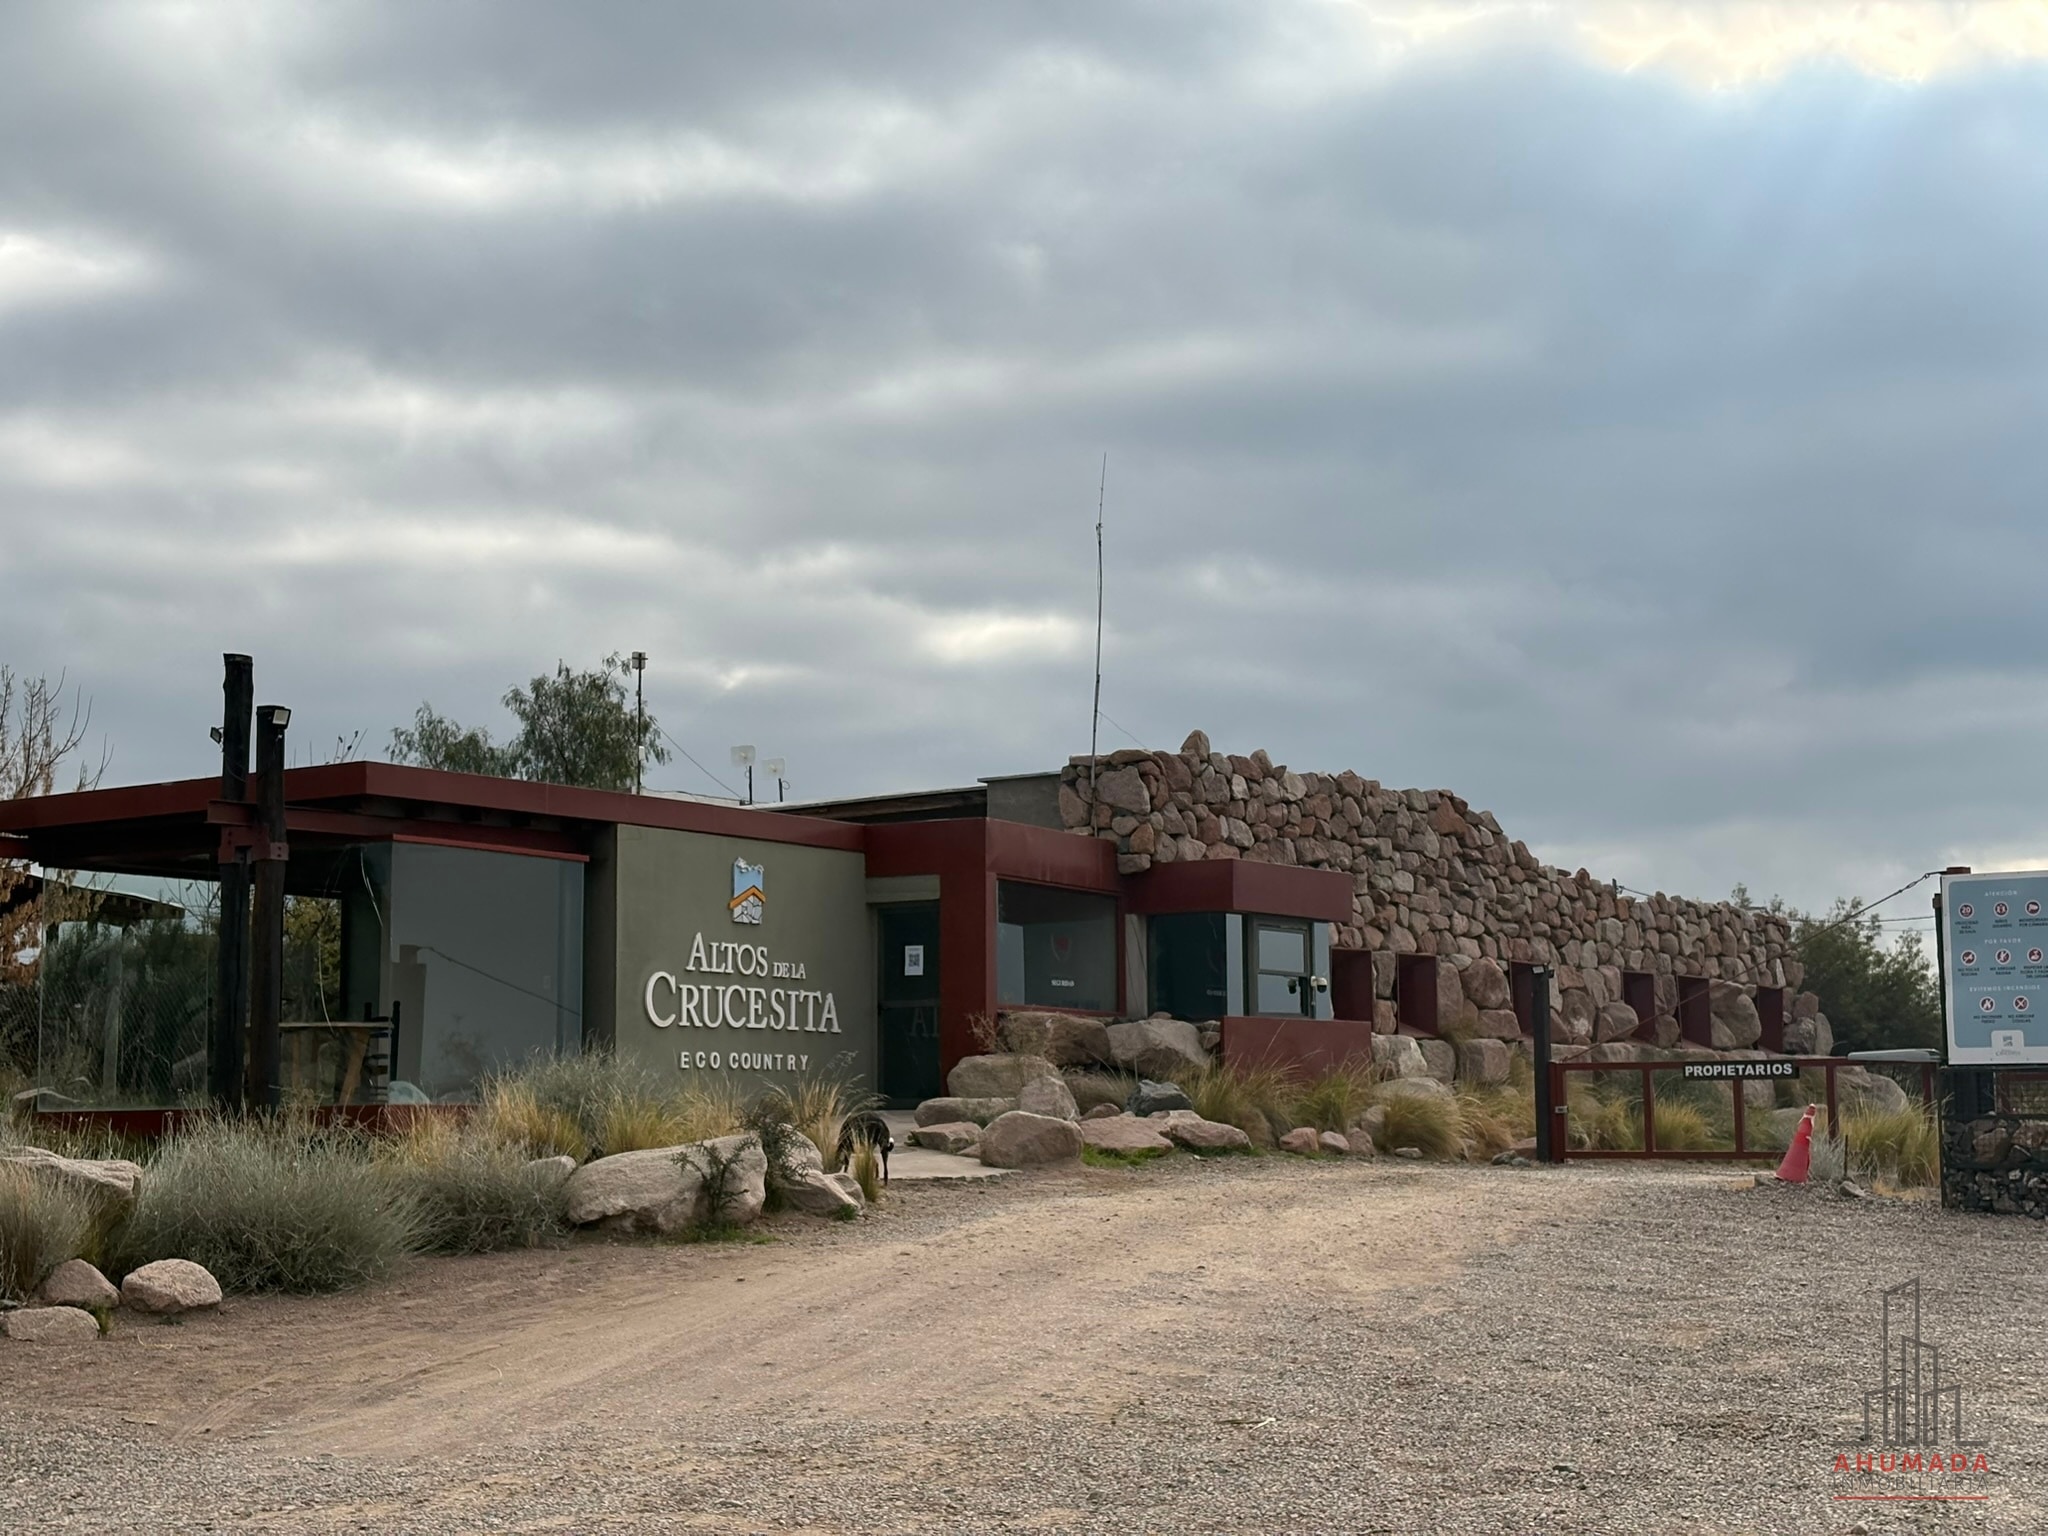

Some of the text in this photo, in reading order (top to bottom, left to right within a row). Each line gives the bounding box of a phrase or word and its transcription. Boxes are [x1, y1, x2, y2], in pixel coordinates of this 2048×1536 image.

[685, 931, 806, 980] ALTOS DE LA
[644, 970, 842, 1034] CRUCESITA
[680, 1050, 809, 1072] ECO COUNTRY
[1684, 1063, 1793, 1077] PROPIETARIOS
